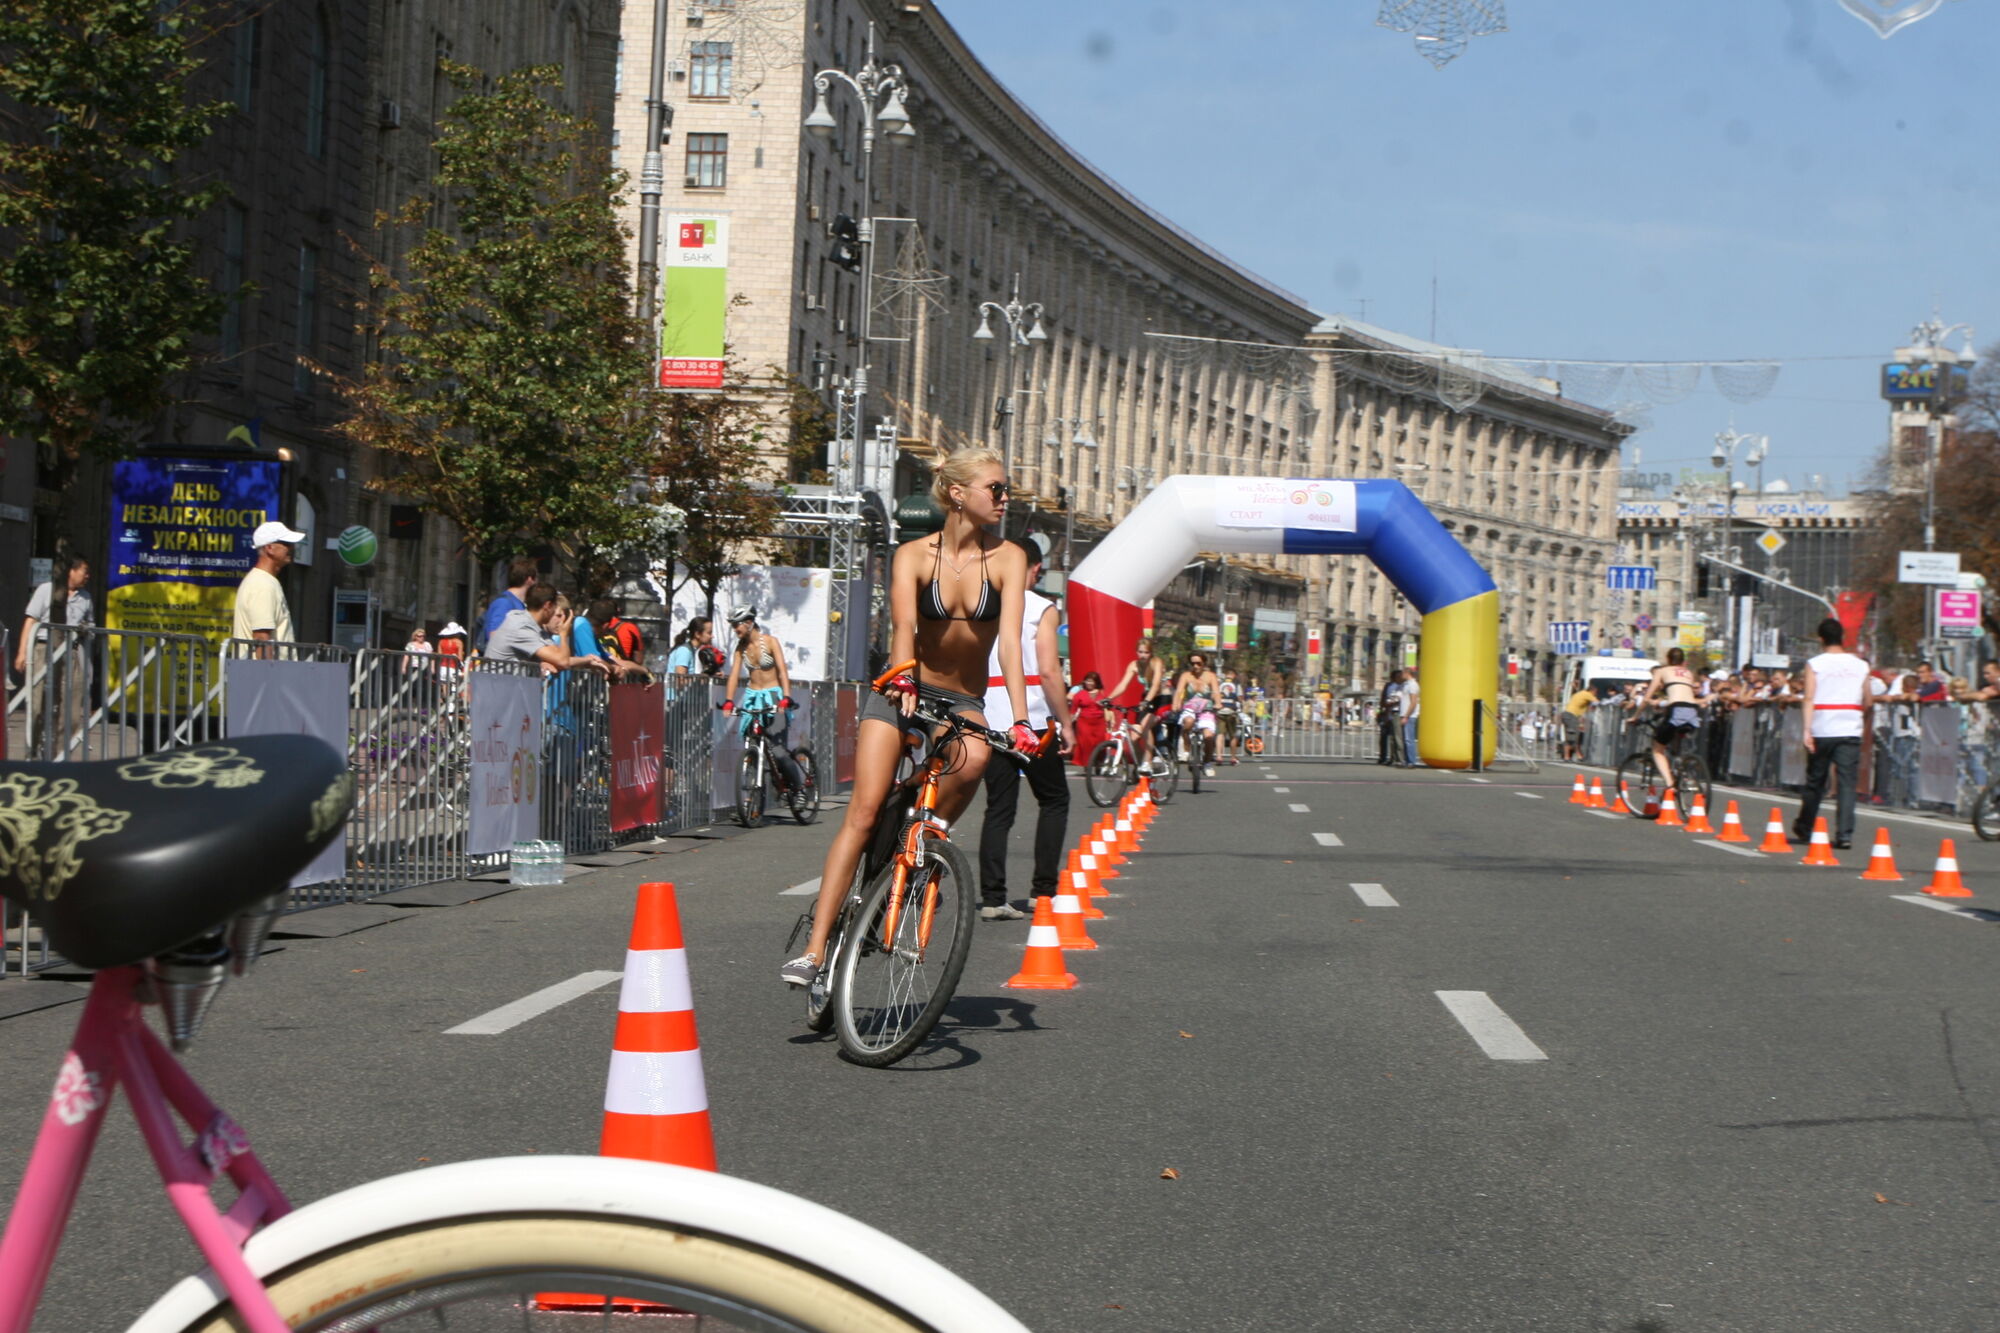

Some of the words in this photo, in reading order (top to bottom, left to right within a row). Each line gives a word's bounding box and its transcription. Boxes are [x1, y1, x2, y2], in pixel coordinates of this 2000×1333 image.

[683, 252, 712, 262] БАНК
[171, 483, 220, 503] ДЕНЬ
[122, 505, 266, 528] НЕЗАЛЕЖНОСТІ
[1230, 510, 1263, 520] СТАРТ
[152, 528, 234, 553] УКРАЇНИ
[138, 552, 178, 566] Майдан
[180, 554, 250, 567] Незалежності
